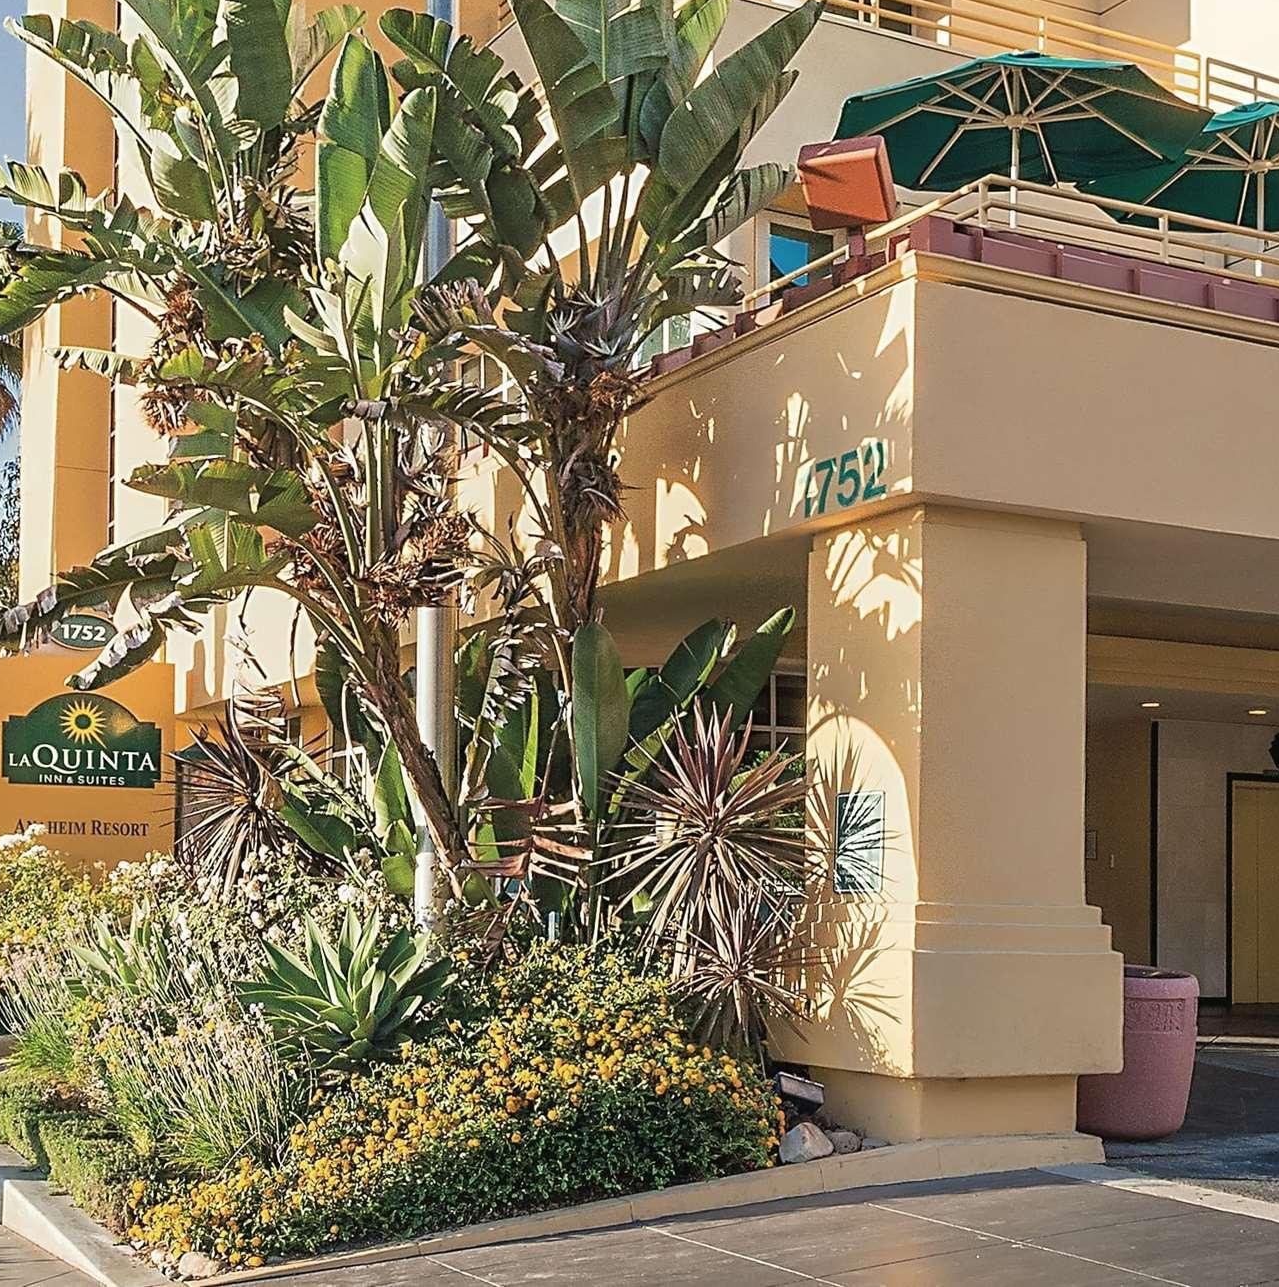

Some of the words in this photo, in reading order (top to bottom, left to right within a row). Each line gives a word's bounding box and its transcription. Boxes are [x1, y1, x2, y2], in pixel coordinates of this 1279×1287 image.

[801, 440, 887, 518] 1752
[60, 624, 107, 642] 1752
[39, 774, 62, 783] INN
[66, 775, 74, 784] &
[77, 775, 125, 786] SUITES
[14, 819, 86, 835] AHEIM
